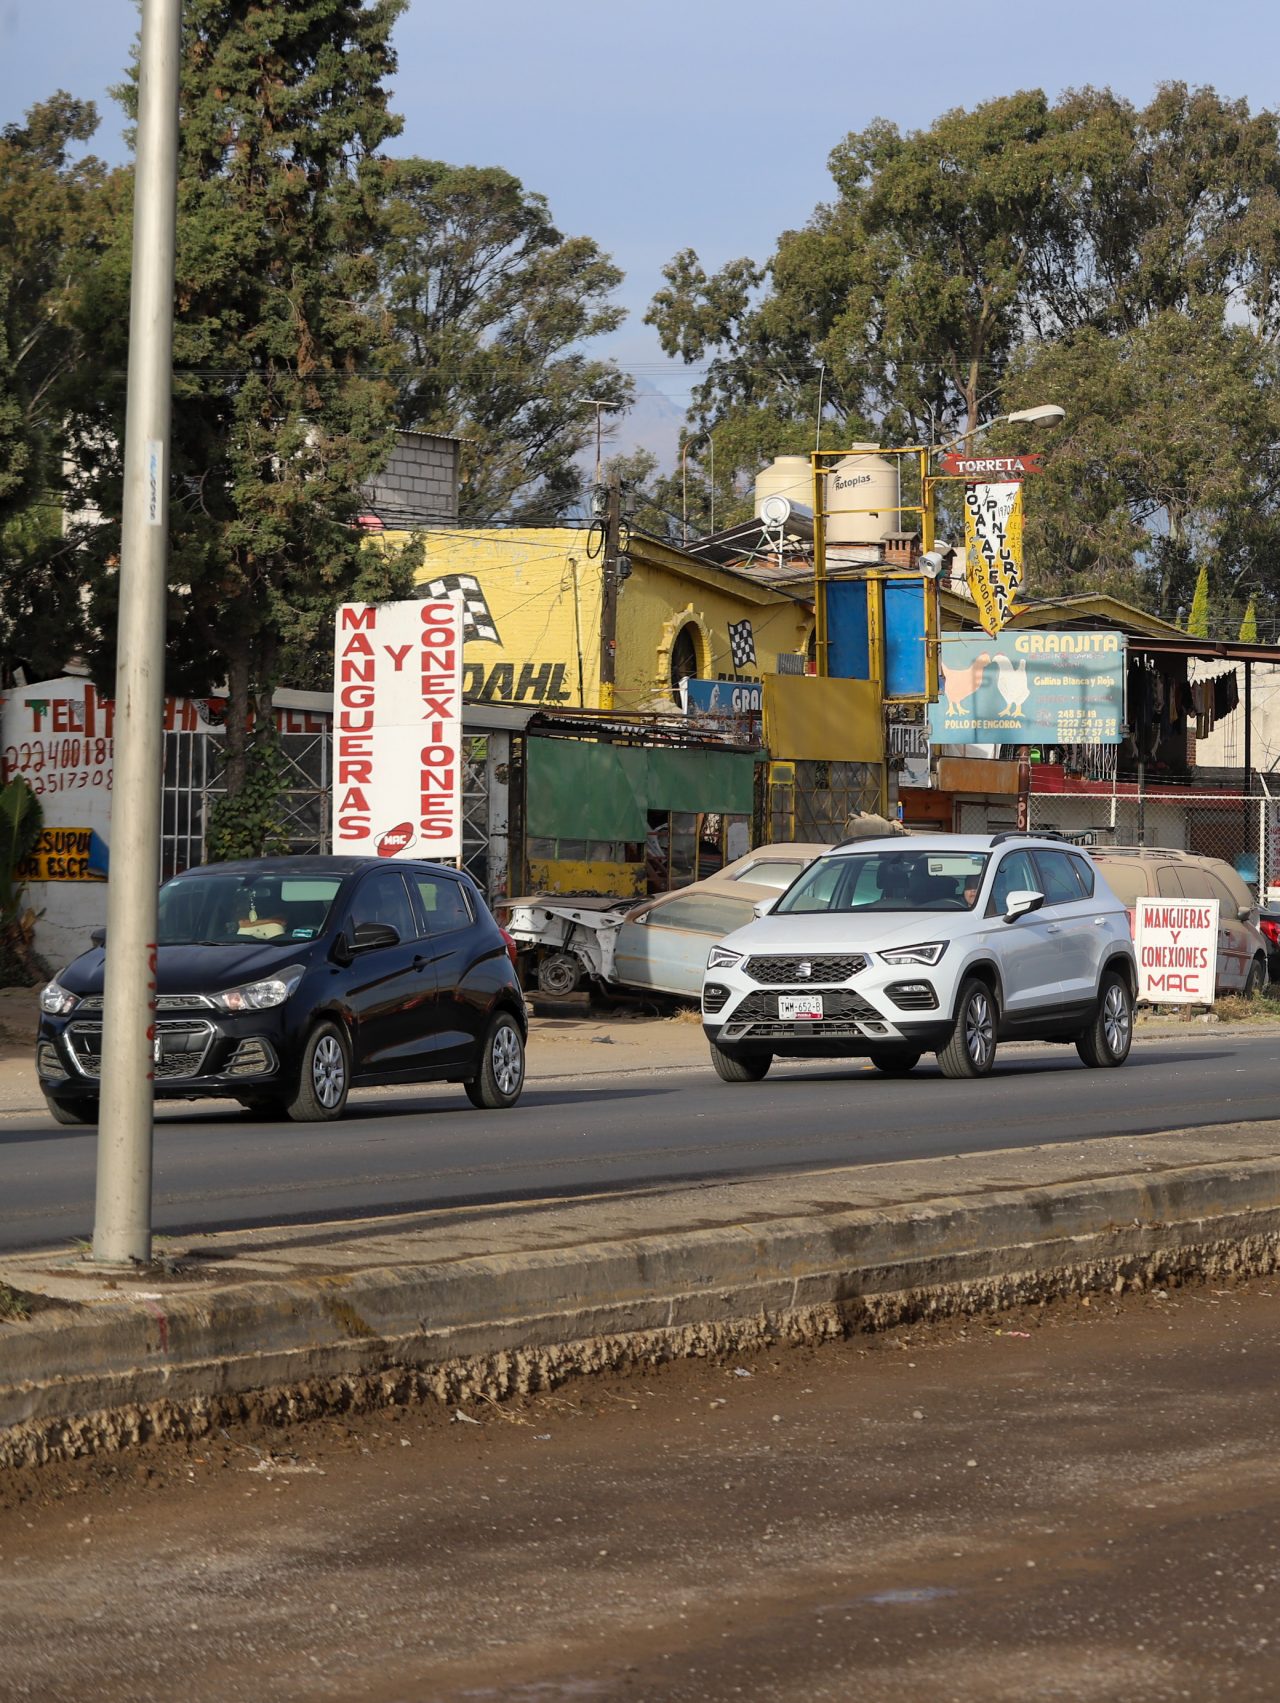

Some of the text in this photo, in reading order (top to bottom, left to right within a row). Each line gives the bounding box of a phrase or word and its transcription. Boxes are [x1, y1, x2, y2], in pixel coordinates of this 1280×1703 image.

[956, 459, 1025, 472] TORRETA
[835, 475, 871, 491] Rotoplas
[986, 501, 1019, 589] PINTURA
[1014, 634, 1118, 653] GRANJITA
[383, 645, 414, 672] Y
[1063, 676, 1088, 686] Blanca
[732, 688, 762, 713] GRA
[338, 607, 376, 840] MANGUERAS
[420, 603, 455, 840] CONEXIONES
[944, 720, 1022, 729] POLLO DE ENGORDA
[1057, 719, 1079, 728] 2222
[384, 834, 407, 845] MAC
[1144, 907, 1211, 929] MANGUERAS
[1170, 930, 1181, 944] Y
[1141, 946, 1208, 968] CONEXIONES
[1147, 974, 1199, 992] MAC
[781, 1002, 821, 1012] TWM-652-B
